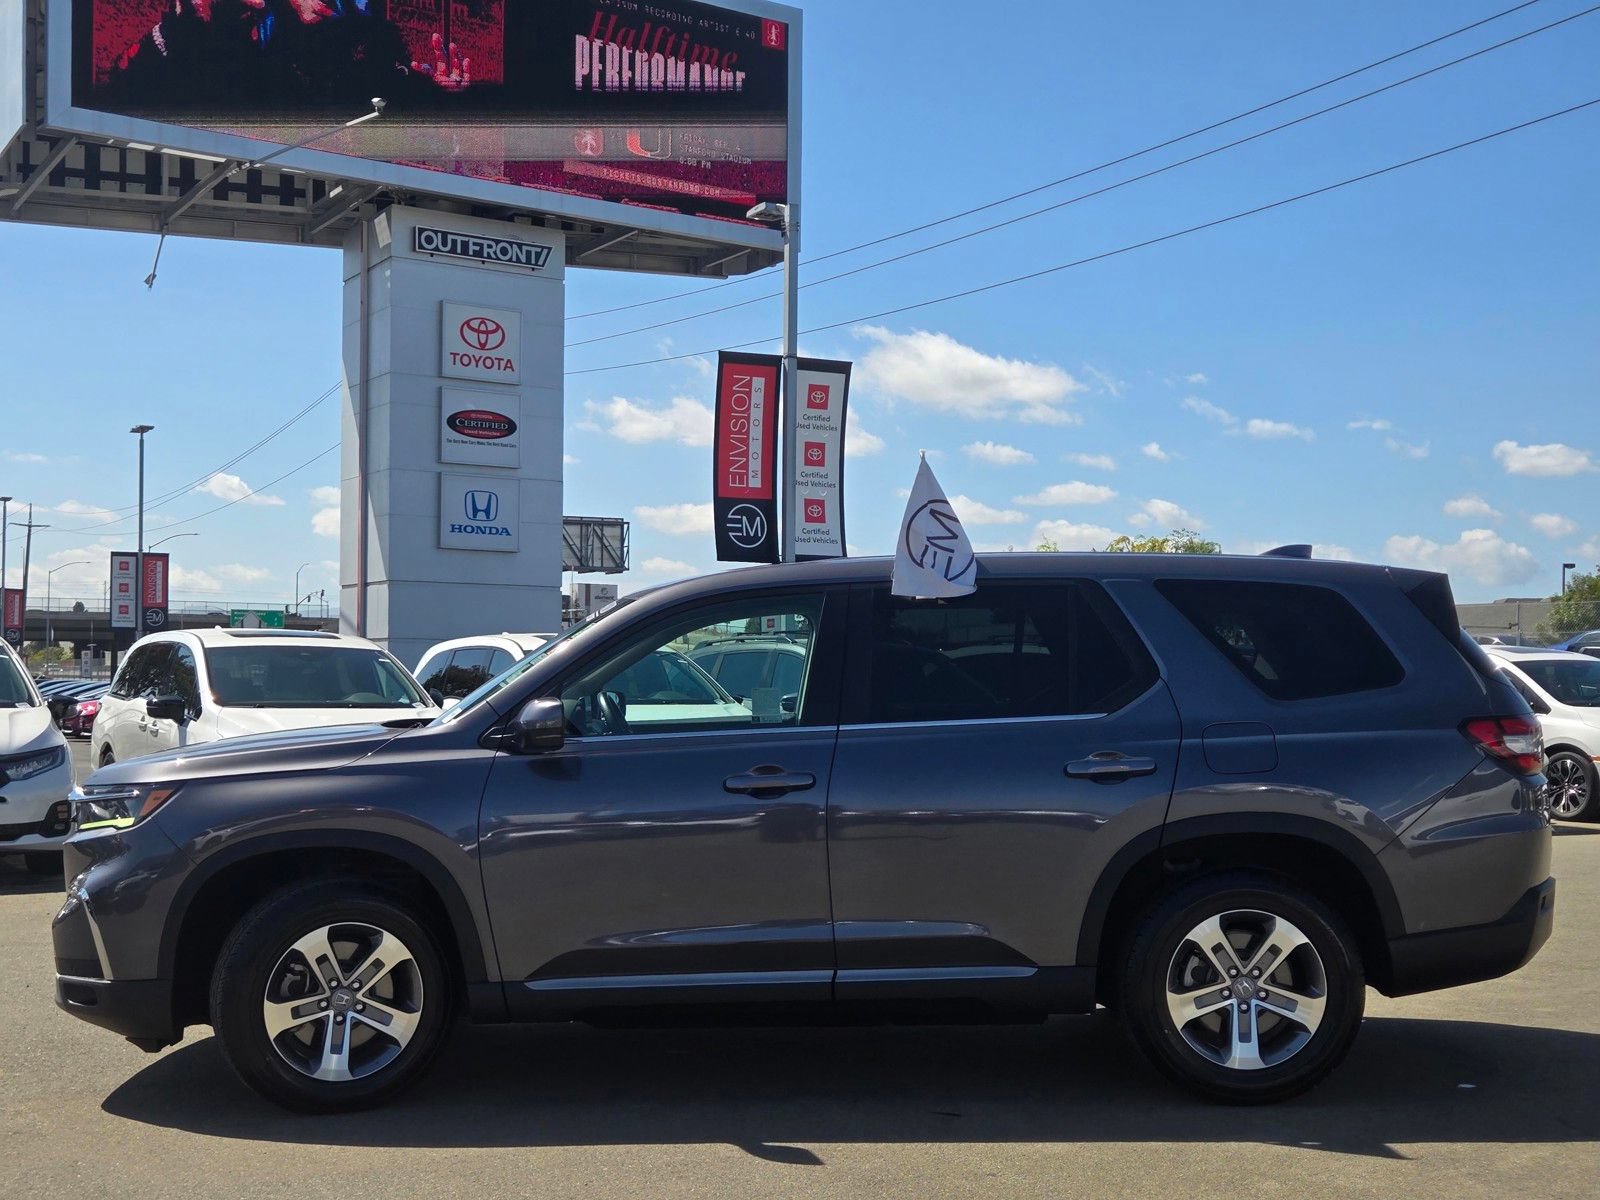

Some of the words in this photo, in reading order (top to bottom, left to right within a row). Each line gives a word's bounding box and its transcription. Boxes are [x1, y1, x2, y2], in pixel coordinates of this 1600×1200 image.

[586, 10, 738, 73] Halftime
[449, 352, 515, 372] TOYOTA
[802, 413, 831, 422] Certified
[729, 375, 750, 488] ENVISION
[751, 387, 762, 478] MOTORS
[812, 423, 838, 432] Vehicles
[800, 471, 829, 479] Certified
[810, 480, 836, 489] Vehicles
[449, 524, 512, 536] HONDA
[801, 527, 830, 536] Certified
[812, 537, 839, 545] Vehicles
[147, 560, 156, 604] ENVISION
